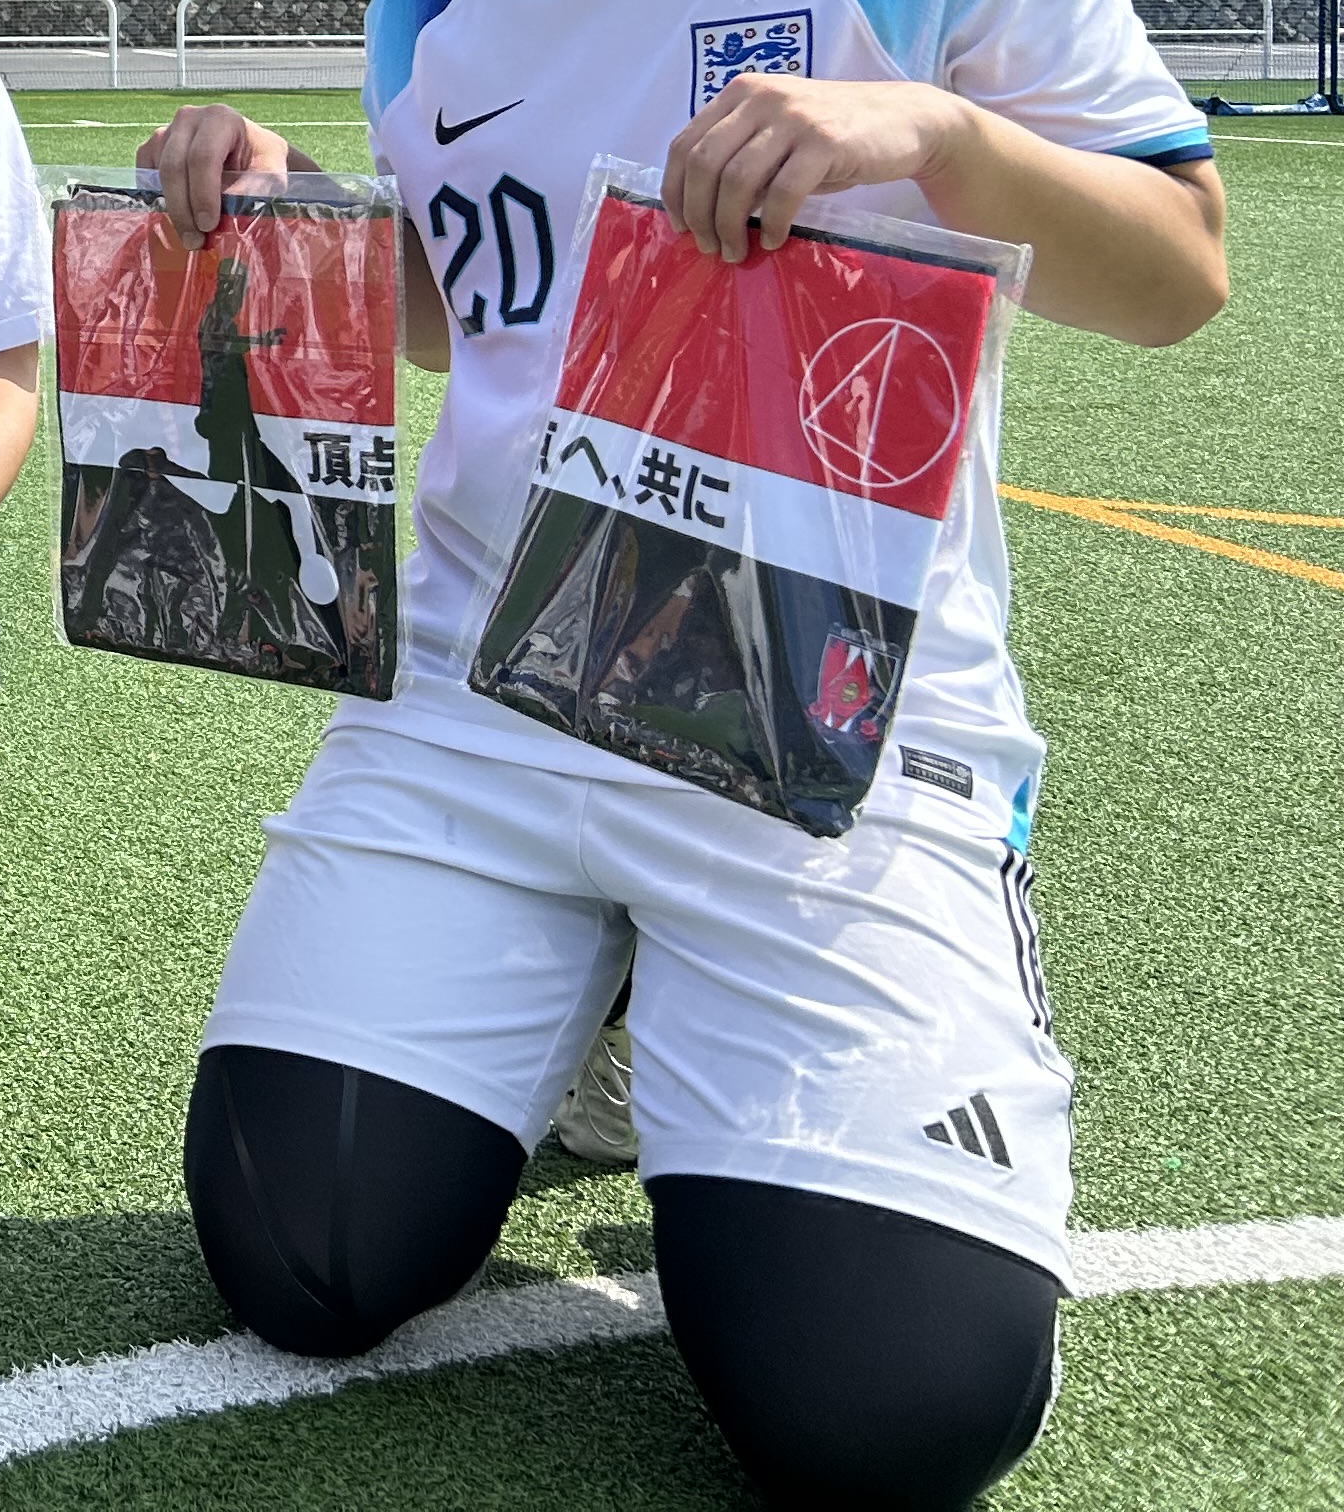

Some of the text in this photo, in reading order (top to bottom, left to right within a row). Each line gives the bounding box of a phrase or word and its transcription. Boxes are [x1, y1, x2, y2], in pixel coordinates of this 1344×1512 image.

[428, 172, 556, 338] 20
[536, 420, 730, 529] へ、共に
